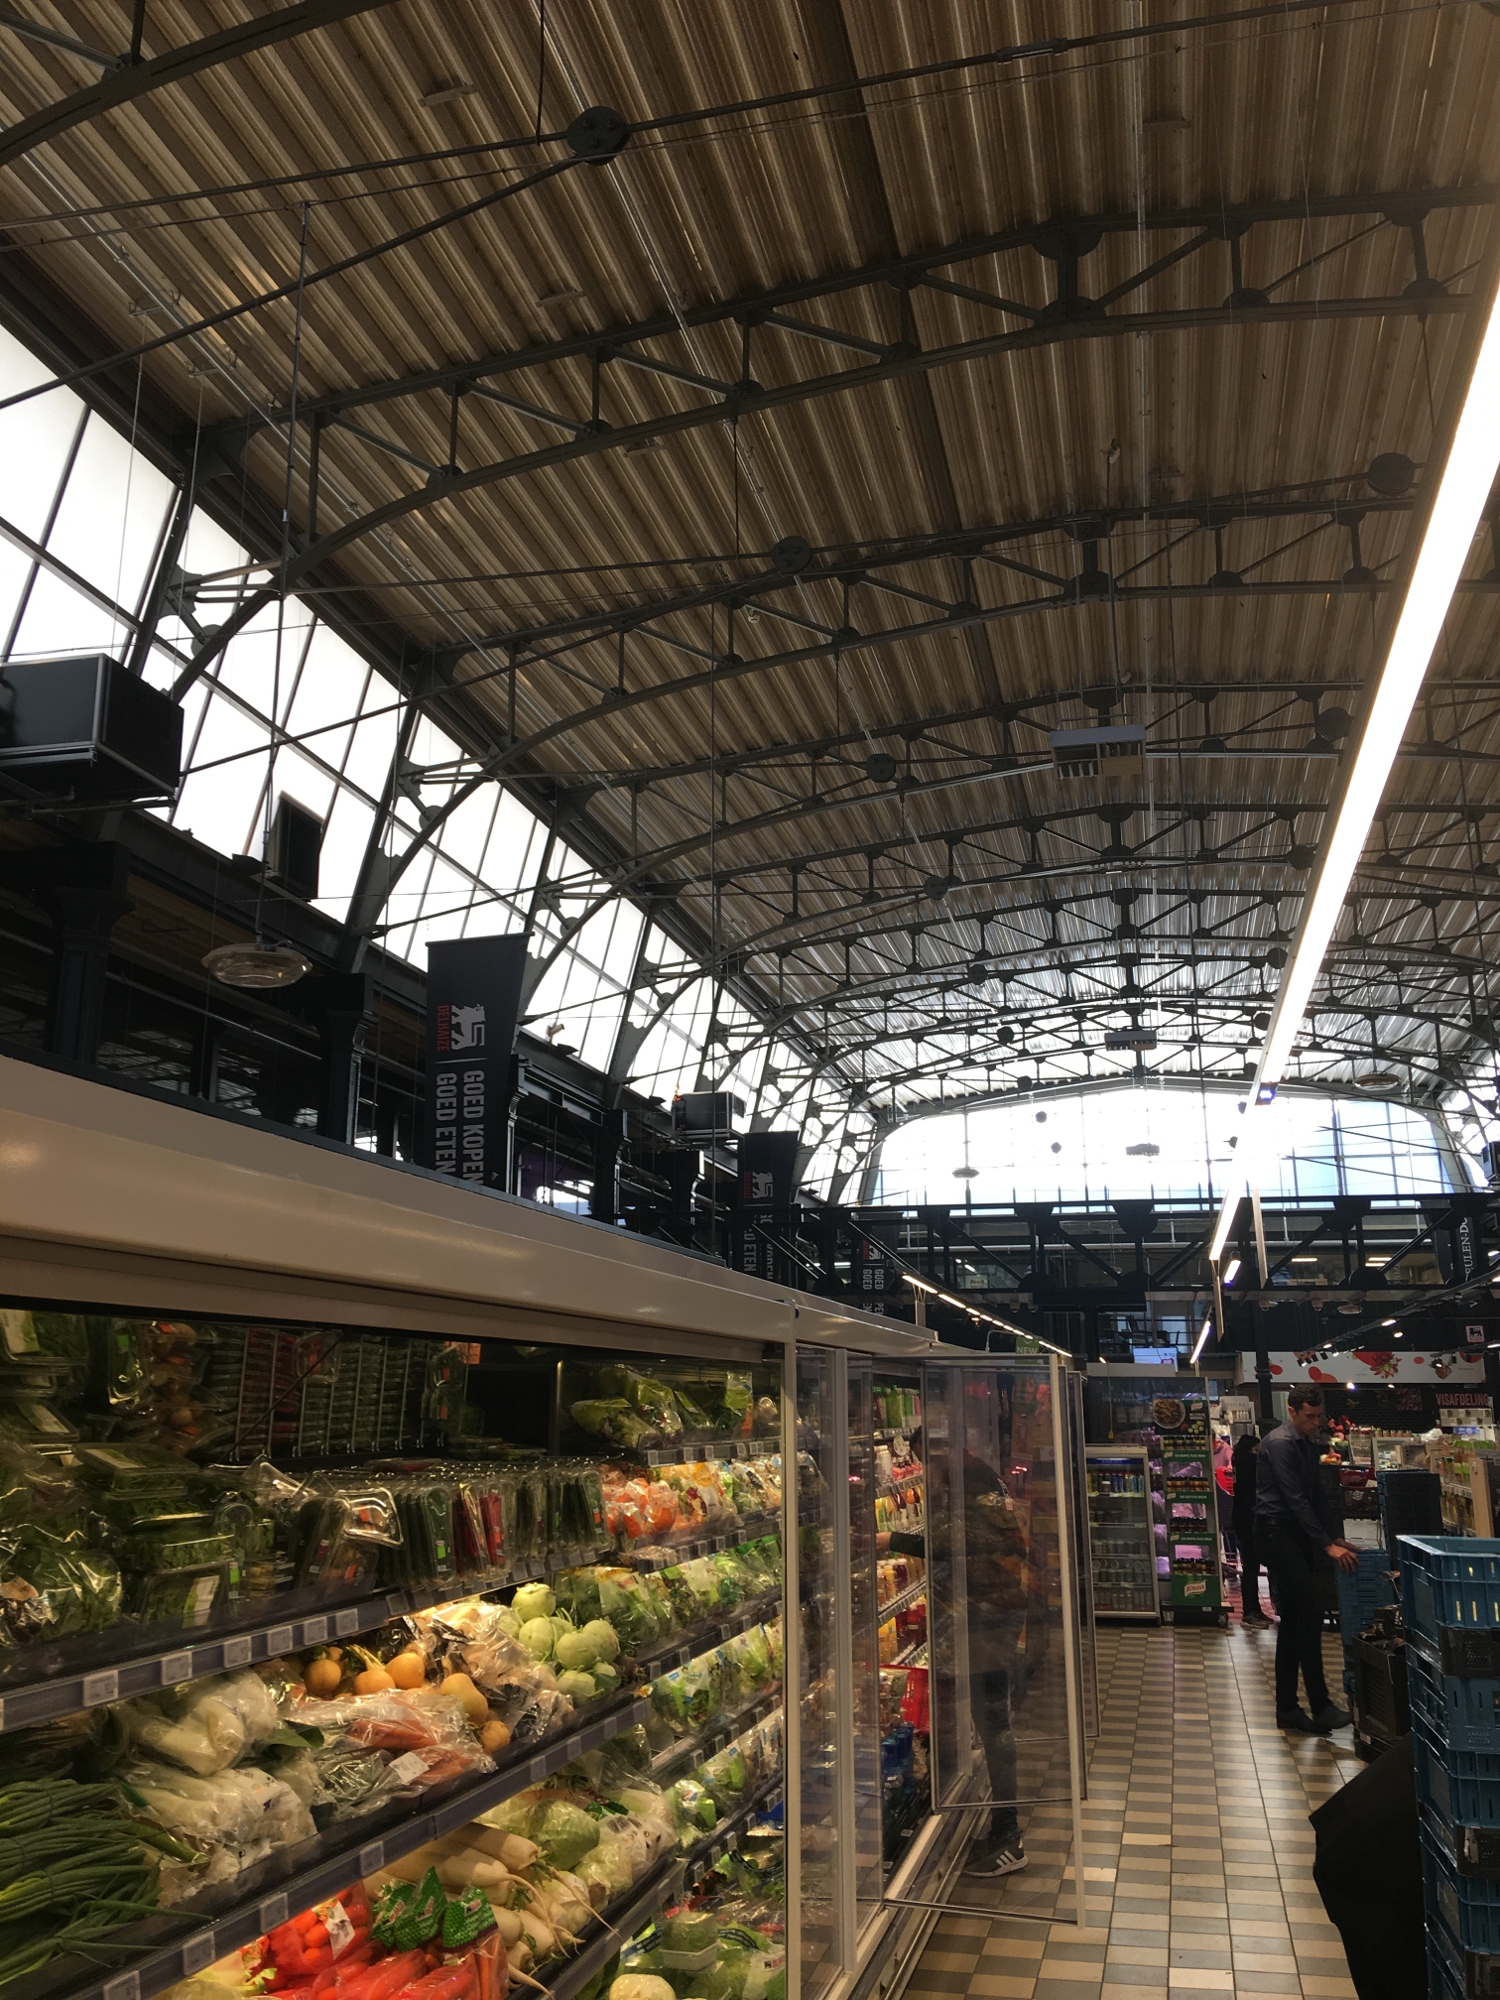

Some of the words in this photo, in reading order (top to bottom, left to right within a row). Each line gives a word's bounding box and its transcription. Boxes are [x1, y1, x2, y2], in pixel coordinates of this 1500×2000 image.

[437, 1004, 451, 1052] DELHAIZE
[436, 1073, 457, 1121] GOED
[463, 1070, 485, 1118] GOED
[435, 1127, 457, 1174] ETEN
[463, 1124, 485, 1185] KOPEN
[743, 1243, 757, 1272] ETEN
[862, 1268, 873, 1290] GOED
[874, 1268, 884, 1290] GOED
[1016, 1346, 1038, 1354] NEW
[1435, 1393, 1489, 1406] VISAFDELING
